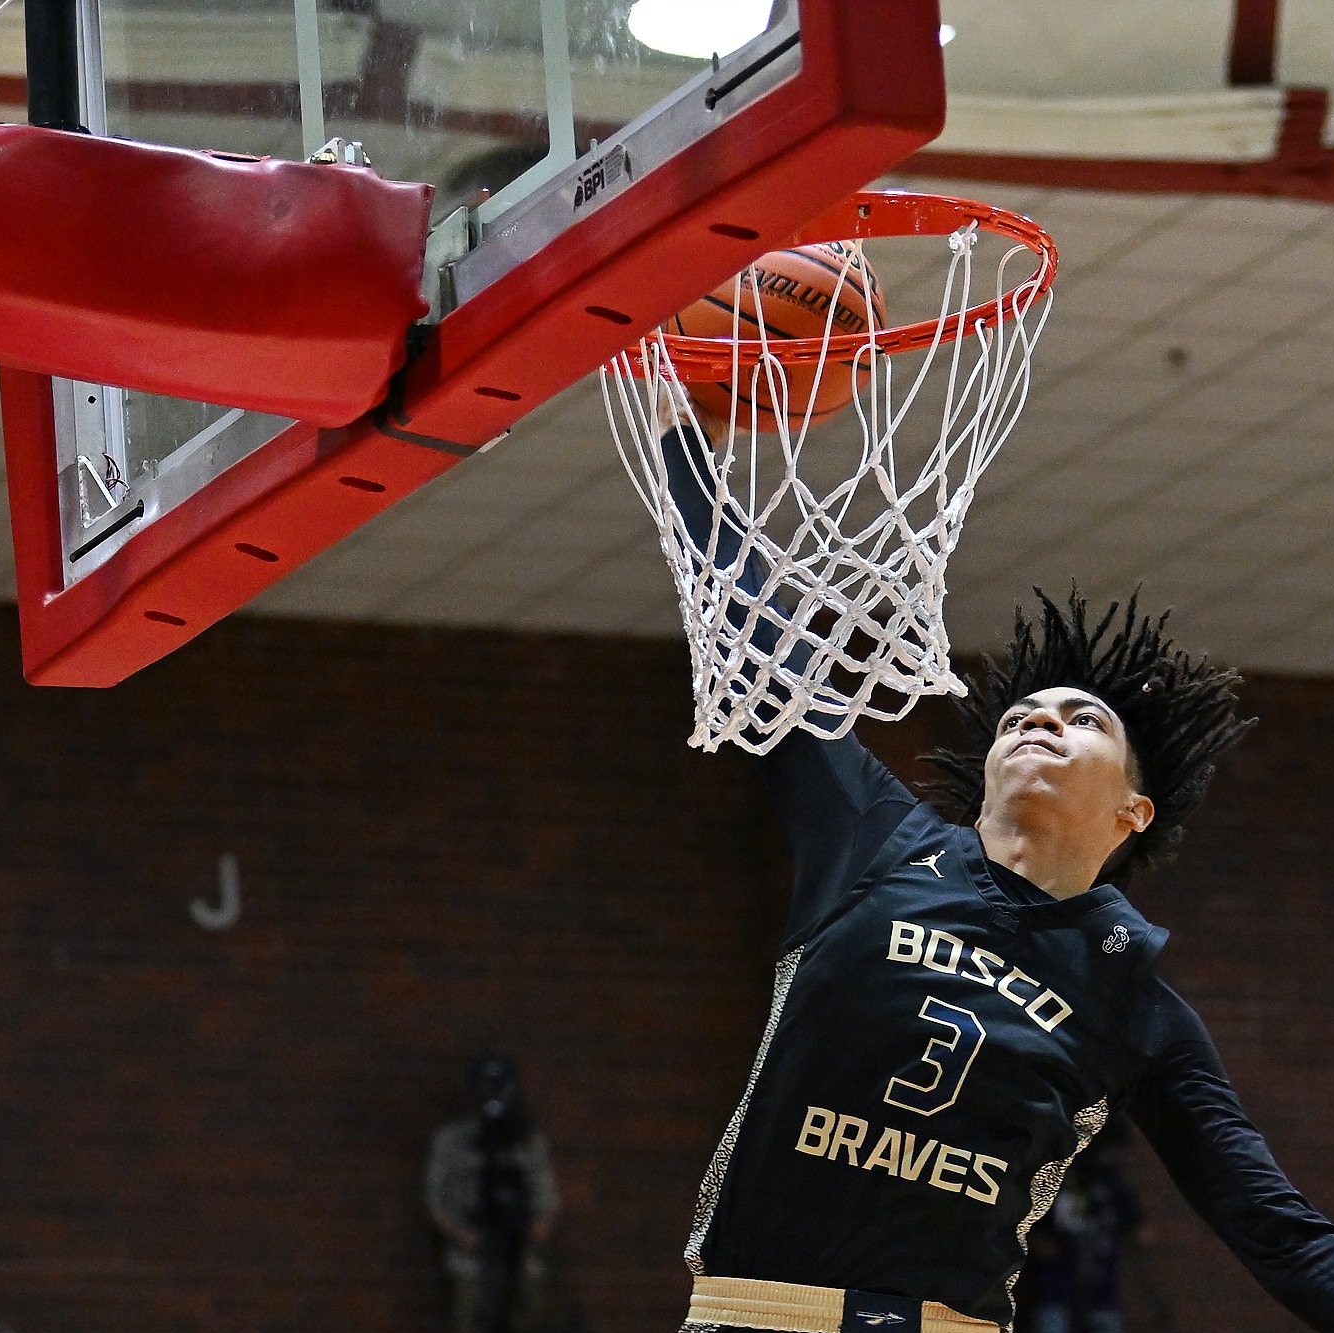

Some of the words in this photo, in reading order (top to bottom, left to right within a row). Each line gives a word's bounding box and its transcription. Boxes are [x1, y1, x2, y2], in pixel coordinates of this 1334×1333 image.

[583, 167, 605, 202] BPI
[190, 853, 240, 930] J
[885, 920, 1074, 1034] BOSCO
[883, 995, 987, 1117] 3
[794, 1105, 1009, 1206] BRAVES
